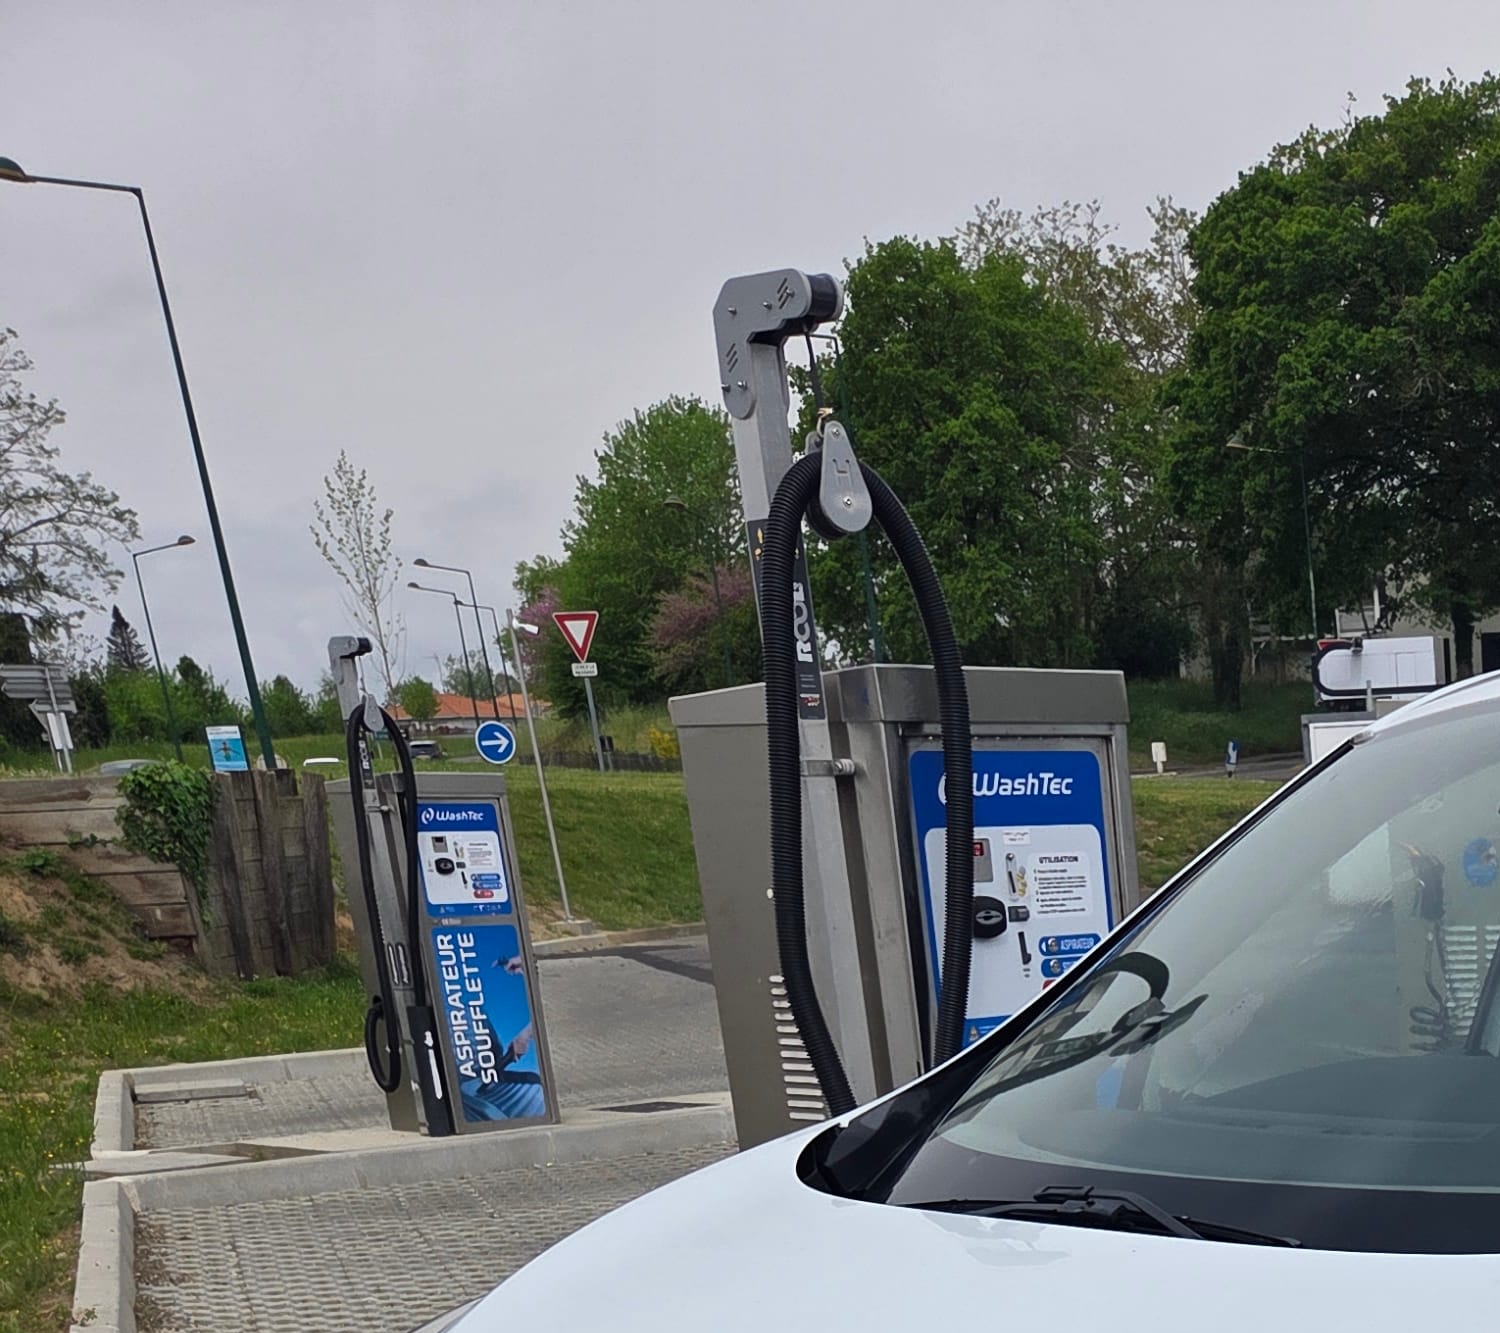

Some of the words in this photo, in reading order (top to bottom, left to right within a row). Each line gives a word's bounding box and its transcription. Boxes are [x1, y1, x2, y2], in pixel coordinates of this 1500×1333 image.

[436, 811, 484, 821] WashTec
[972, 772, 1073, 796] WashTec
[437, 934, 477, 1078] ASPIRATEUR
[457, 932, 498, 1084] SOUFFLETTE
